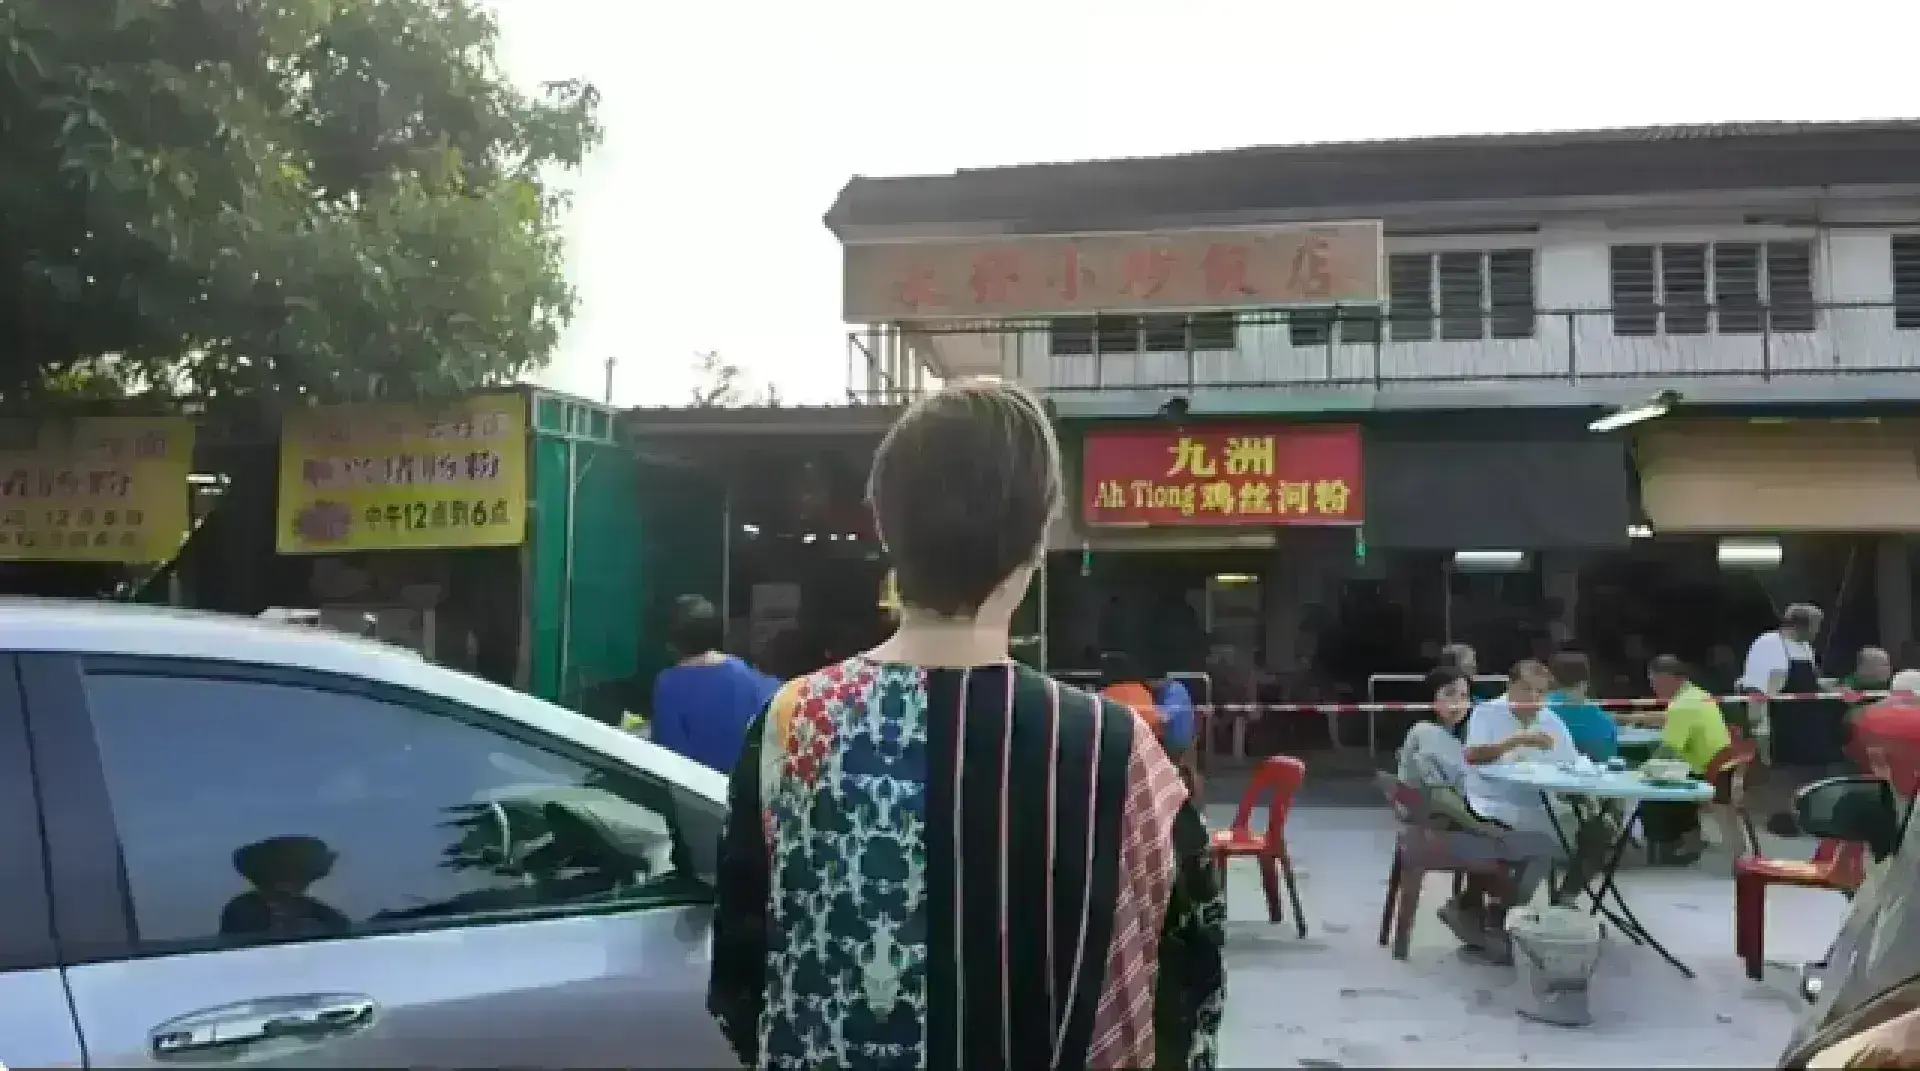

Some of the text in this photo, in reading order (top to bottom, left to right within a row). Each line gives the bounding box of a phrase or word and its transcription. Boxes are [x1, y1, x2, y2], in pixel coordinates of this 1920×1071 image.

[1166, 435, 1276, 477] 九洲
[1093, 480, 1351, 516] Ah Tiong 鸡丝河粉
